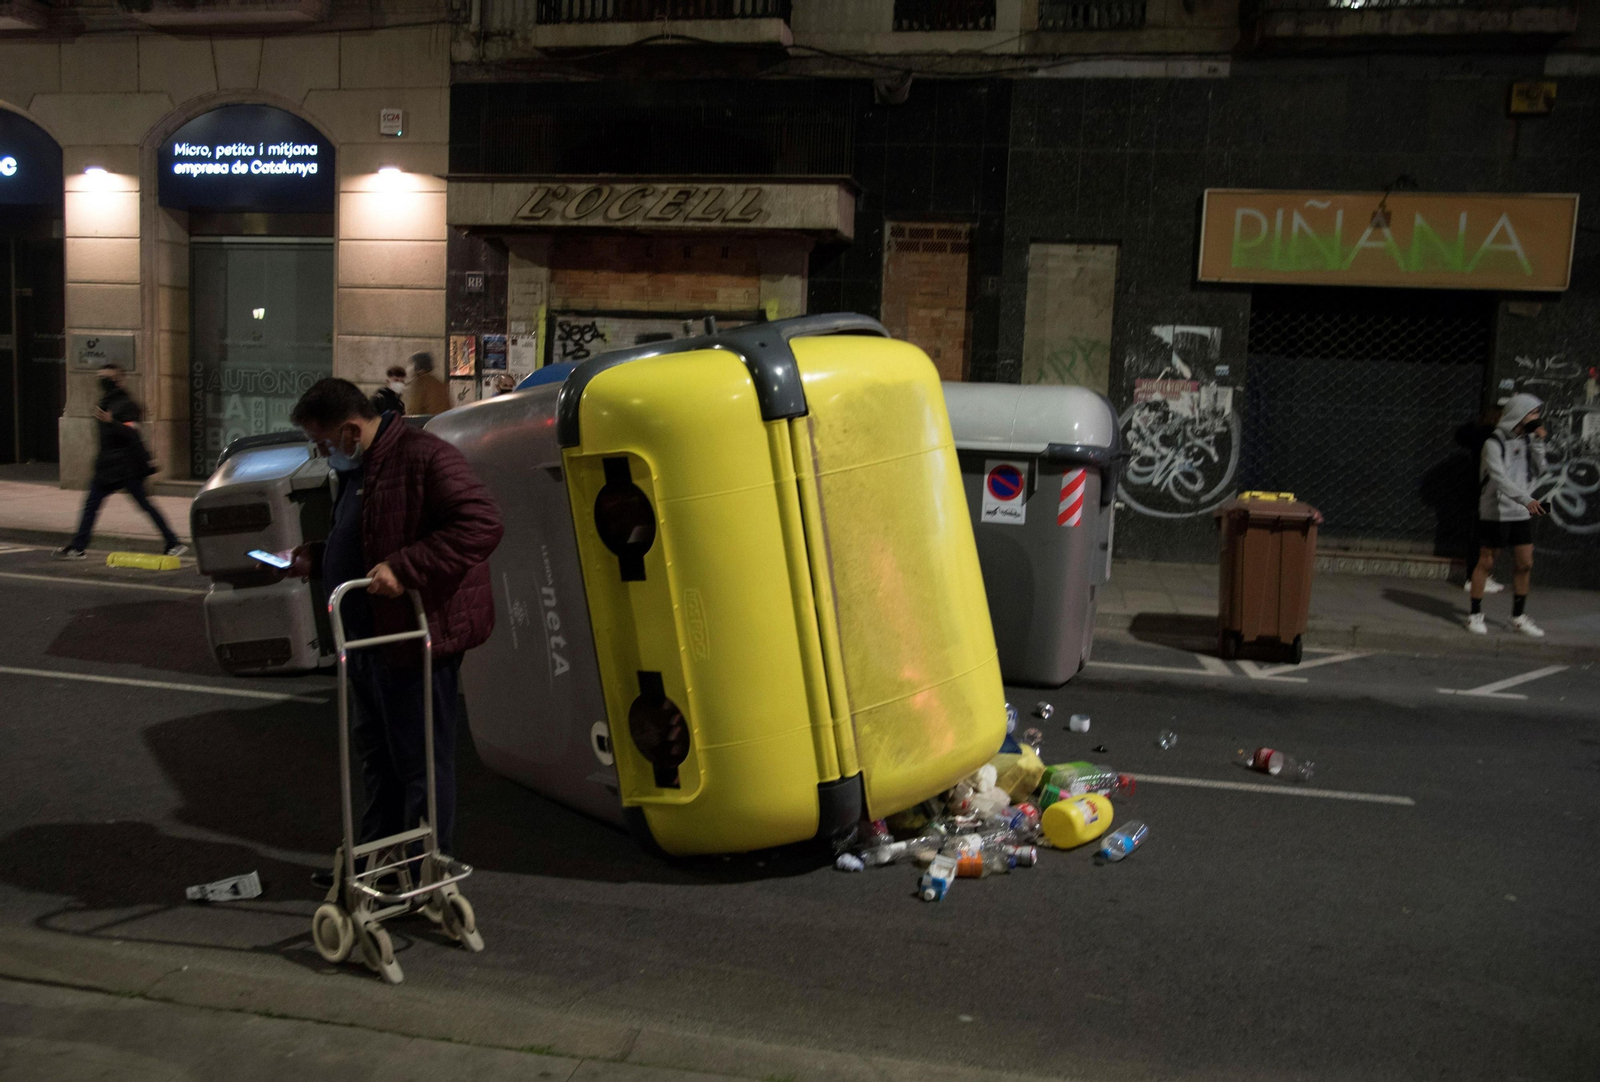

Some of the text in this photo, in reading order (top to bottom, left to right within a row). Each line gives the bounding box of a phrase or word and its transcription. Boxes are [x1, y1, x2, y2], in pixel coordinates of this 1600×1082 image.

[174, 142, 318, 159] Micro, petita i mitjana
[173, 160, 318, 178] empresa de Catalunya
[512, 184, 766, 223] L'OCELL
[1231, 199, 1533, 276] PIÑANA
